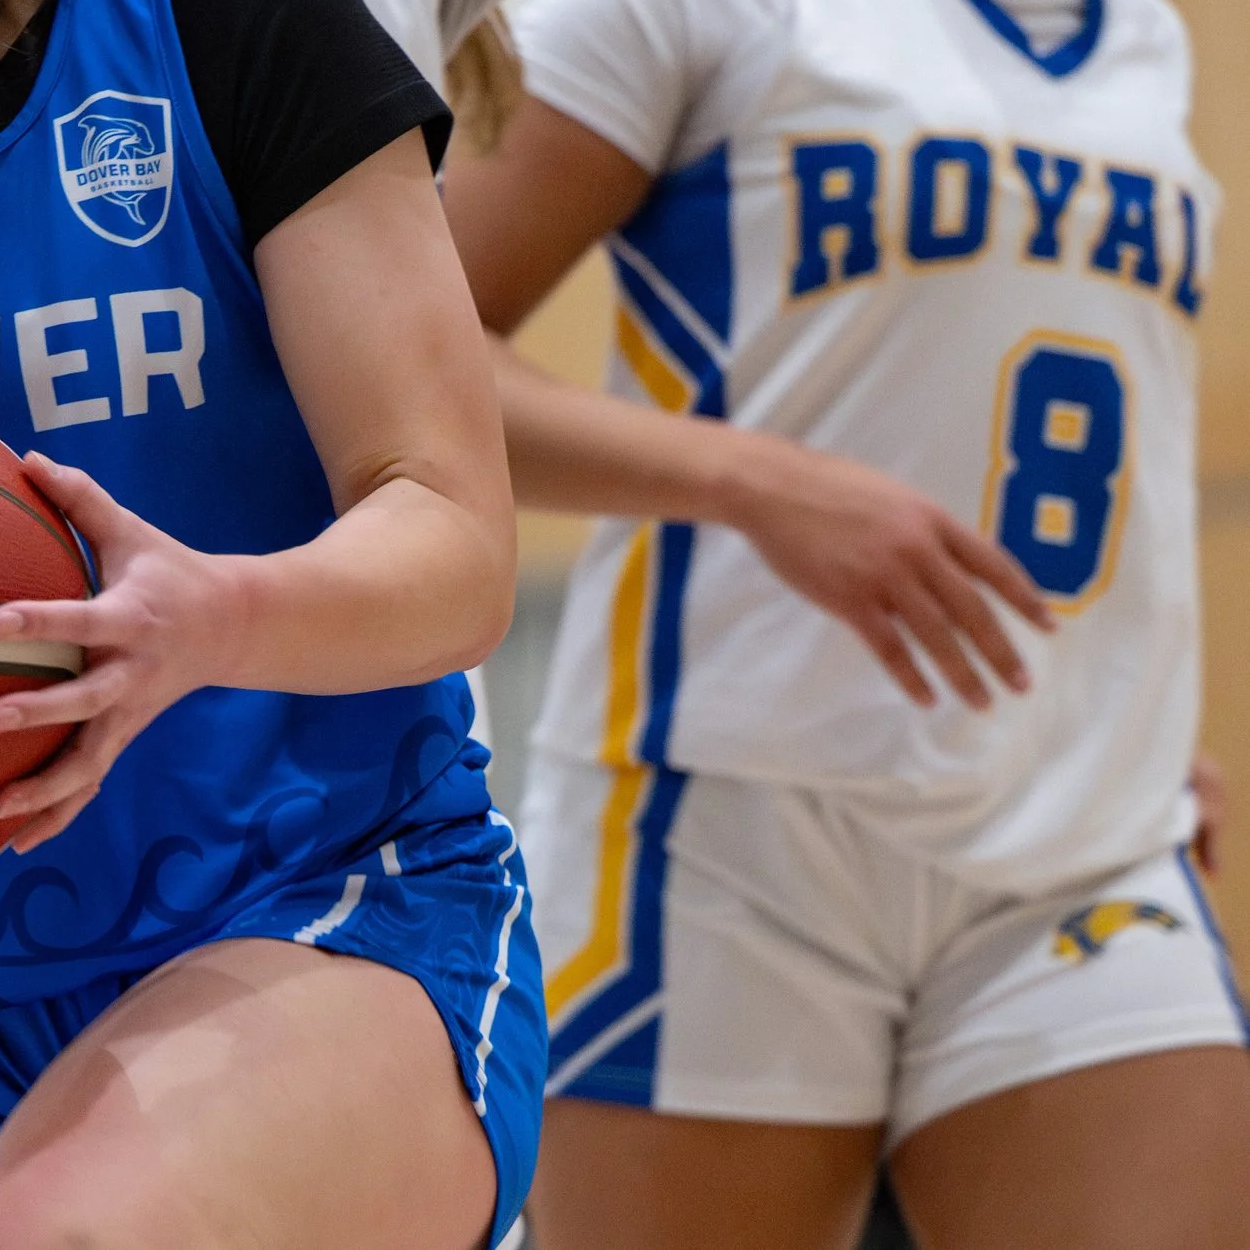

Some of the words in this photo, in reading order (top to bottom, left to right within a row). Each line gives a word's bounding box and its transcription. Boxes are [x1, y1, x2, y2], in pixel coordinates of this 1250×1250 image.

[76, 163, 130, 186] DOVER
[135, 159, 161, 176] BAY
[90, 177, 154, 192] BASKETBALL
[980, 328, 1135, 616] 8
